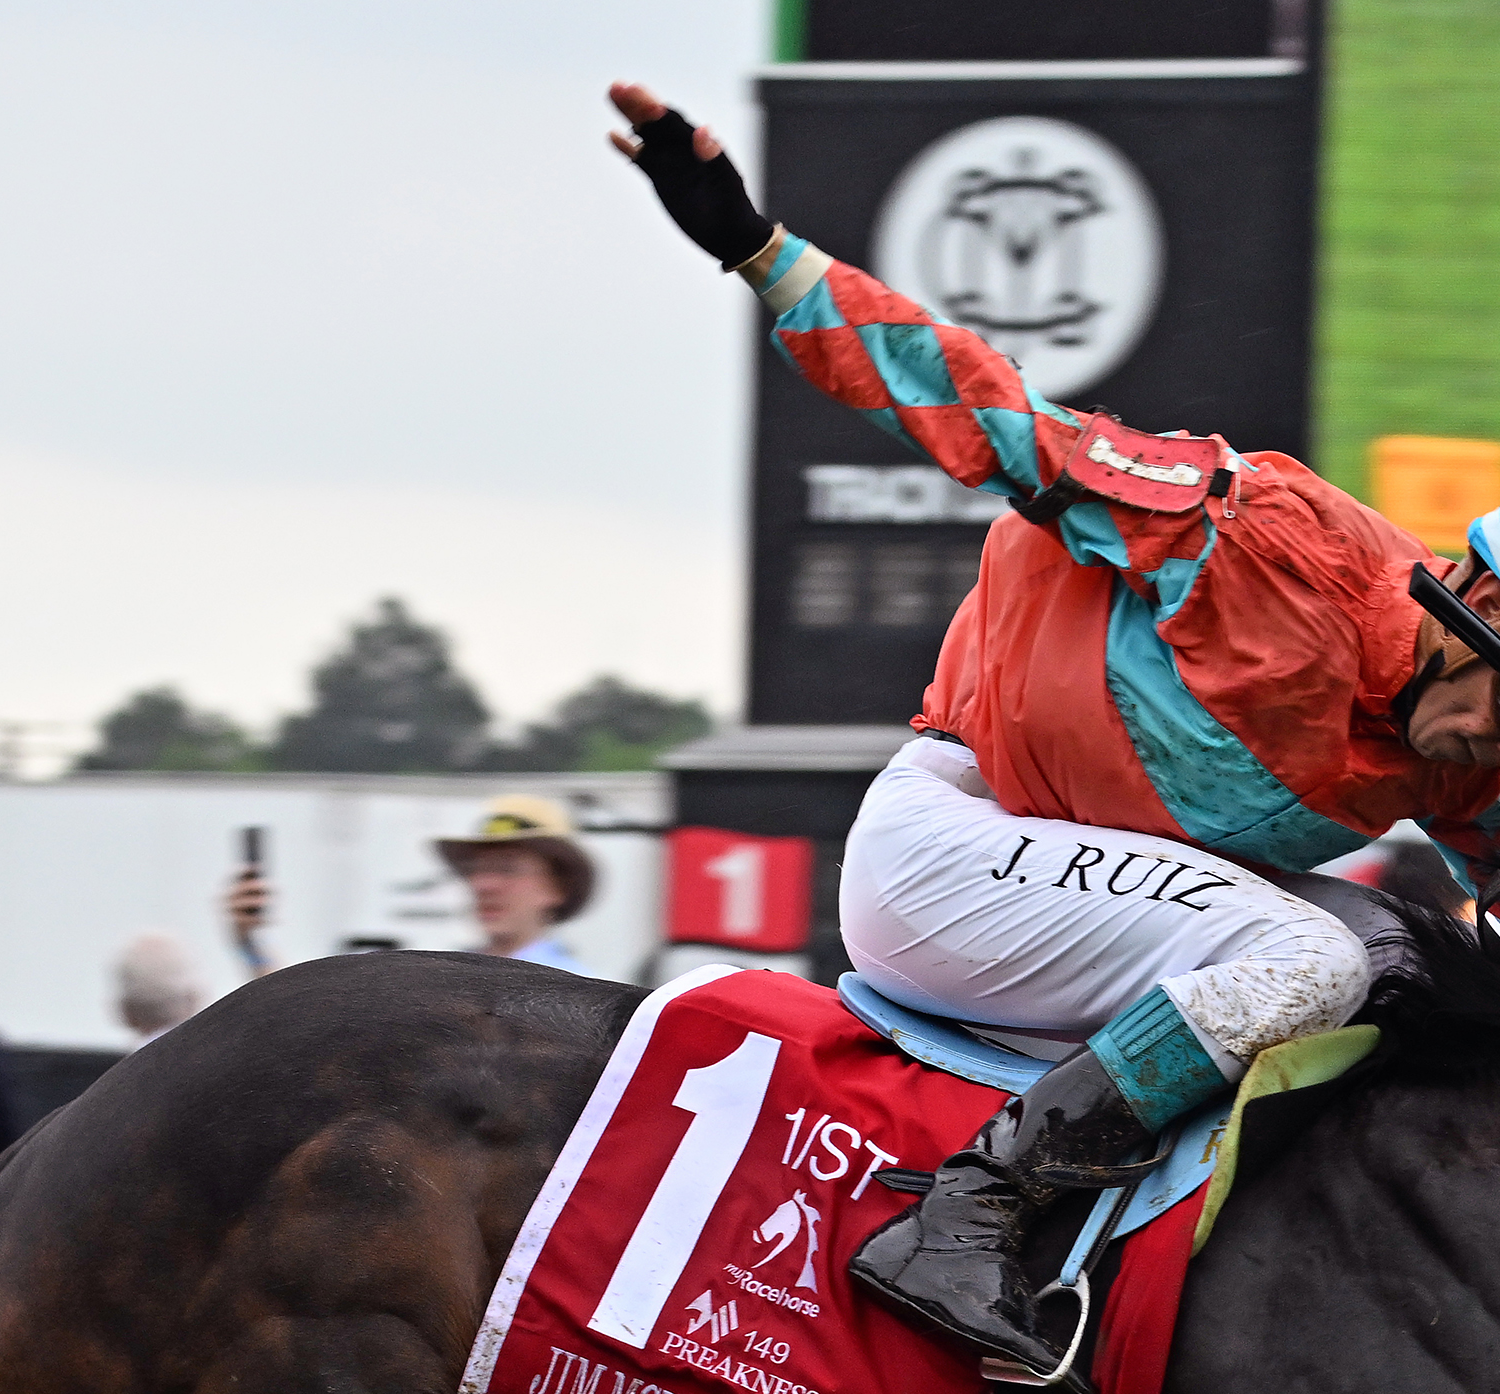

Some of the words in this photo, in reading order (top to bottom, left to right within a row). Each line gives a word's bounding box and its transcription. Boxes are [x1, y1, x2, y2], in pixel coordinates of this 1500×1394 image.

[703, 843, 766, 937] 1
[991, 834, 1037, 884] J.
[1051, 843, 1237, 912] RUIZ
[587, 1031, 783, 1349] 1
[781, 1107, 900, 1200] 1/ST
[722, 1263, 821, 1318] myRacehorse
[743, 1331, 791, 1364] 149
